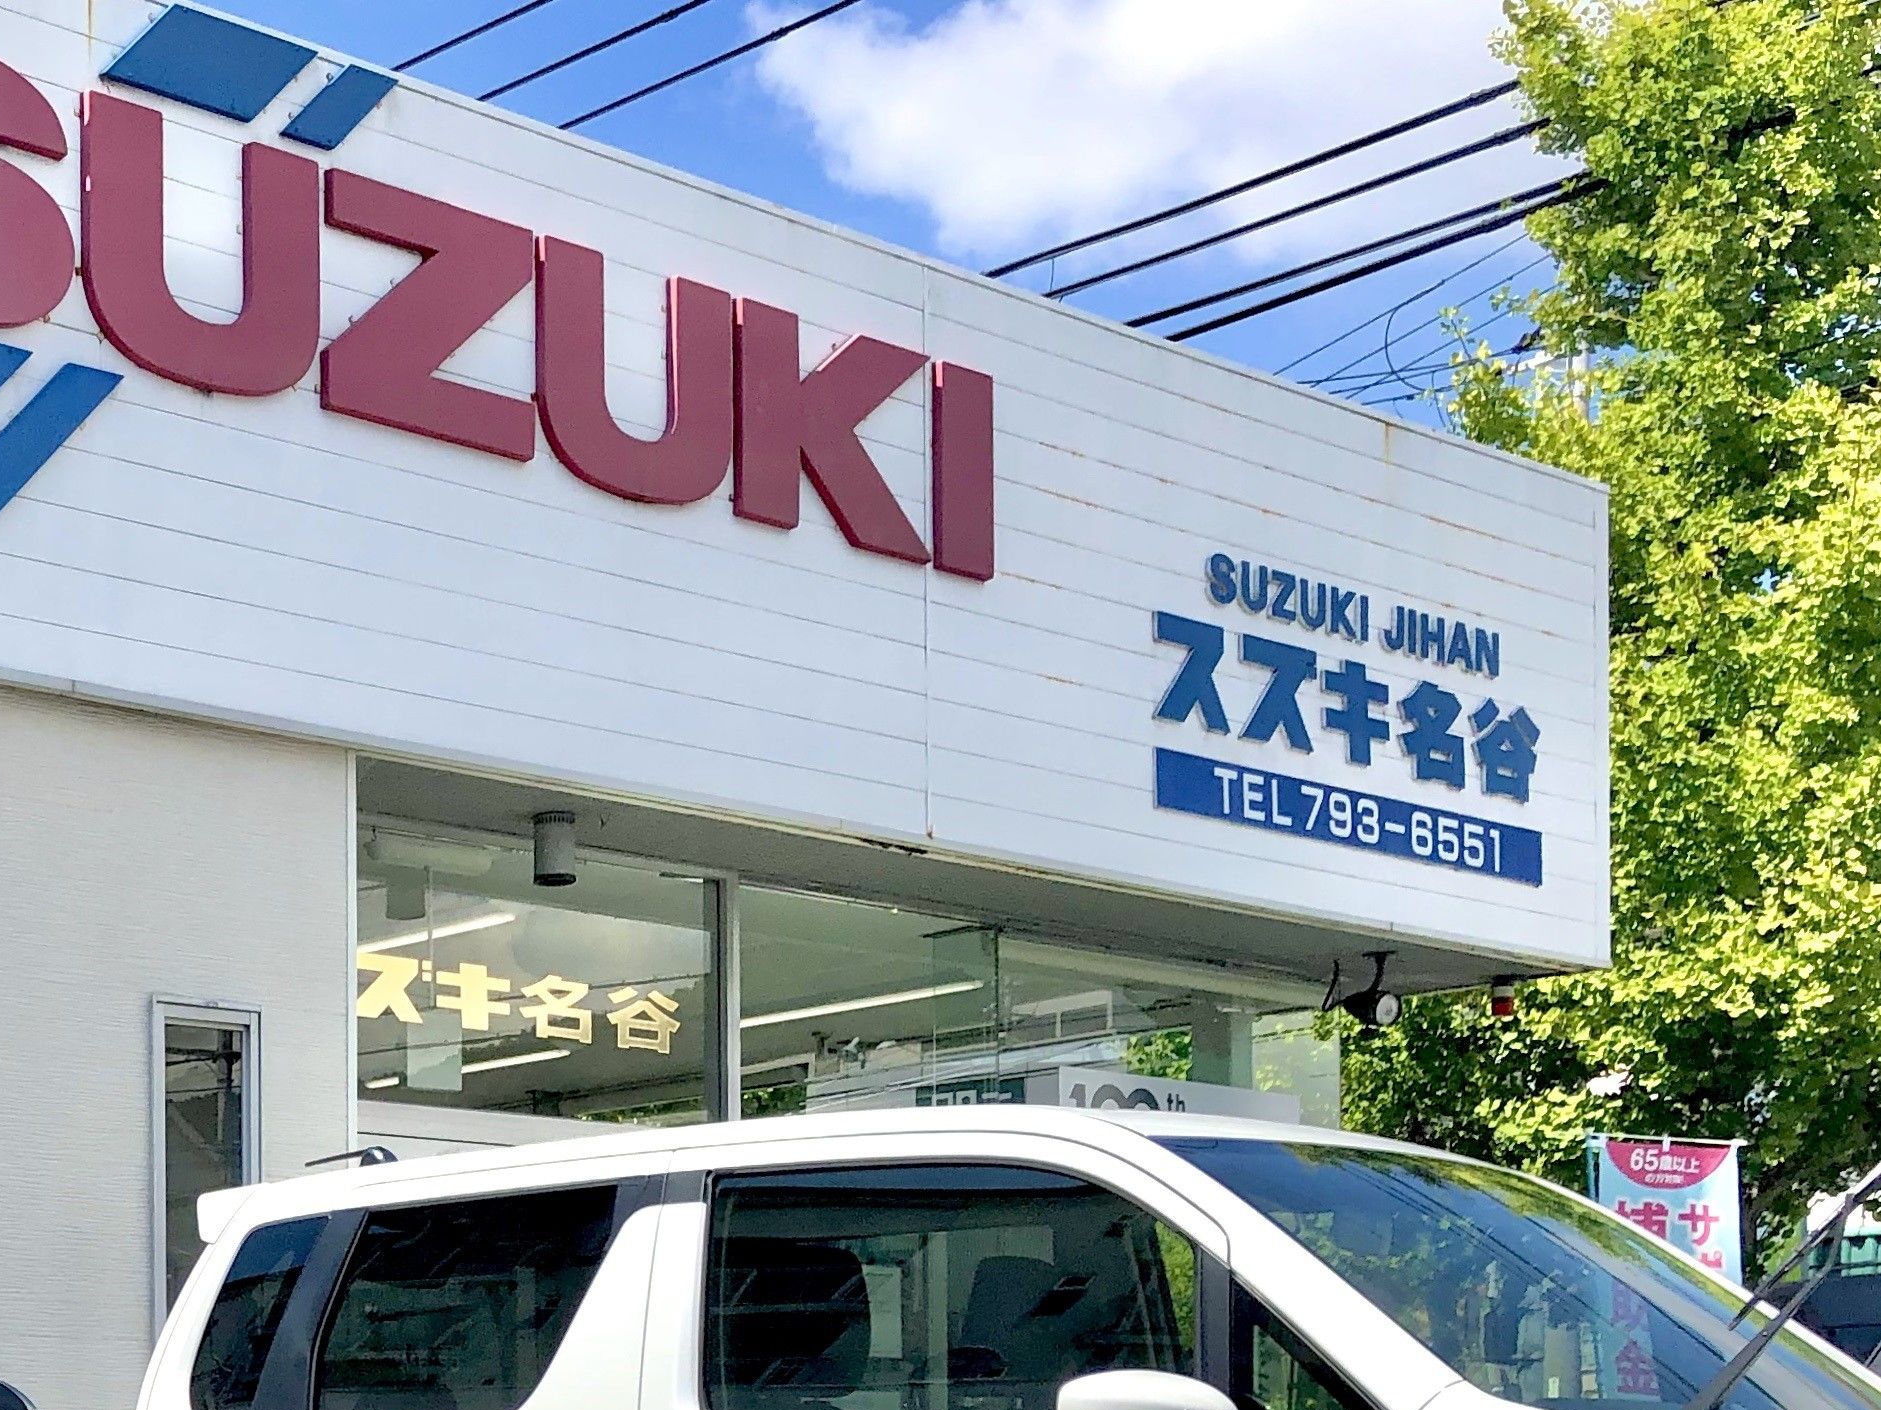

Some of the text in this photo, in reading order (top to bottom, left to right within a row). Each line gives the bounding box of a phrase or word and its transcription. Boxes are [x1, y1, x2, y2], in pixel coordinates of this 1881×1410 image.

[1206, 552, 1501, 681] SUZUKI JIHAN
[1153, 610, 1542, 805] スズキ名谷
[357, 951, 681, 1055] ズキ名谷
